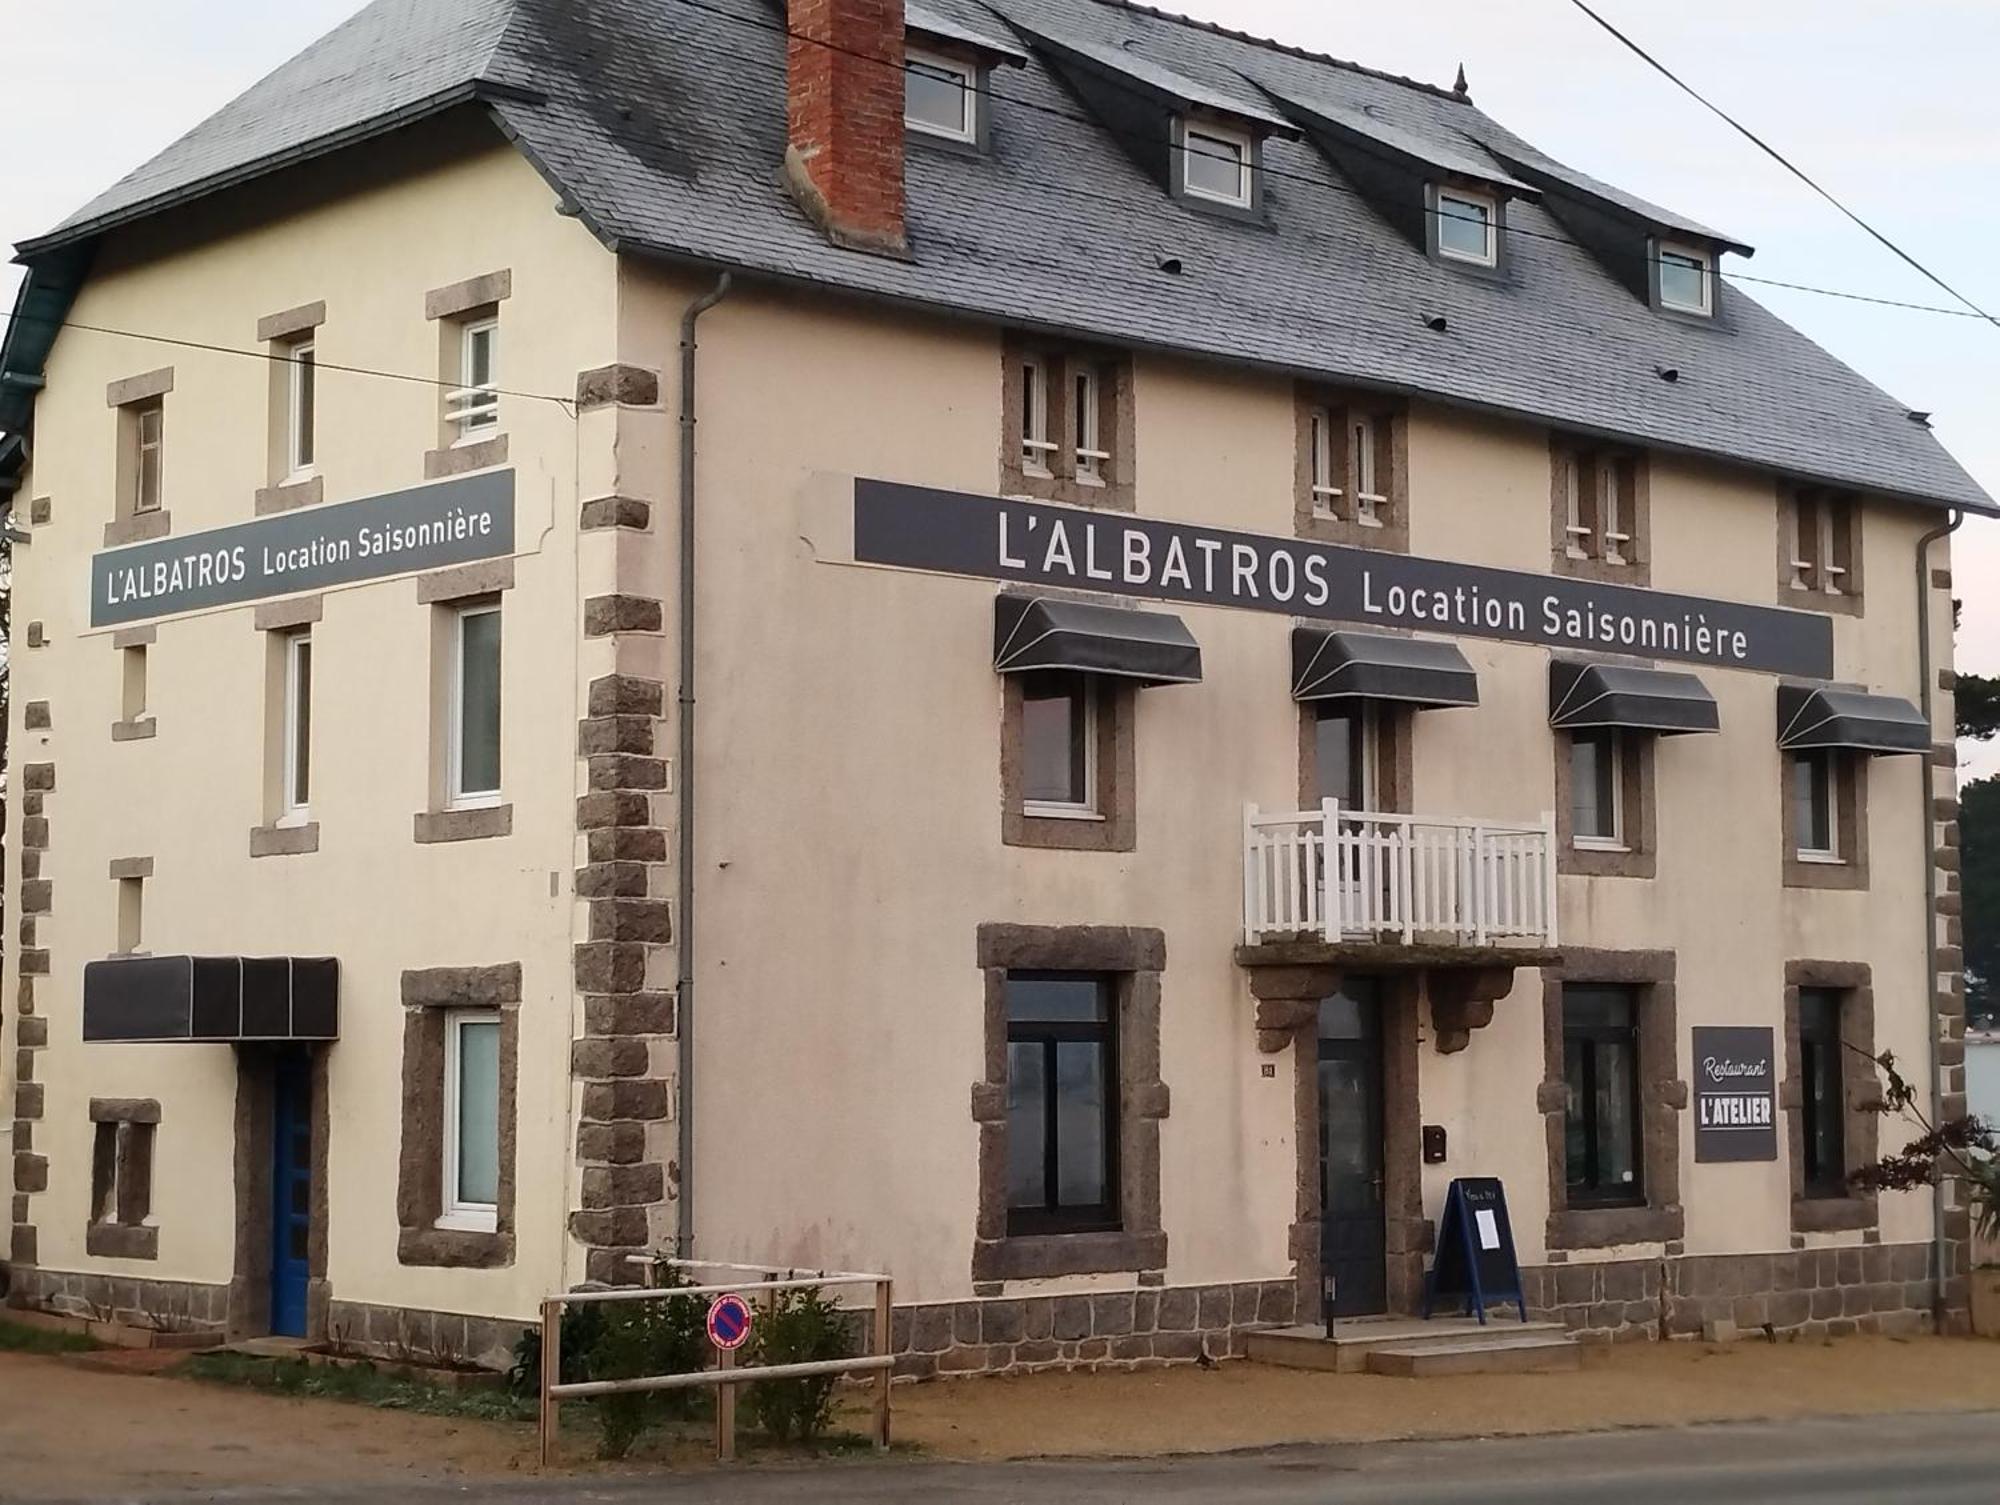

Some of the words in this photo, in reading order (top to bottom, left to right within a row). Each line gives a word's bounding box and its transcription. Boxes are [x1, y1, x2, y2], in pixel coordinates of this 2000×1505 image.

[107, 546, 246, 605] L'ALBATROS
[263, 536, 351, 576] Location
[357, 508, 492, 557] Saisonnière
[999, 511, 1330, 607] L'ALBATROS
[1362, 571, 1526, 632] Location
[1542, 595, 1749, 659] Saisonnière
[1703, 1056, 1767, 1082] Restaurant
[1700, 1097, 1771, 1125] L'ATELIER
